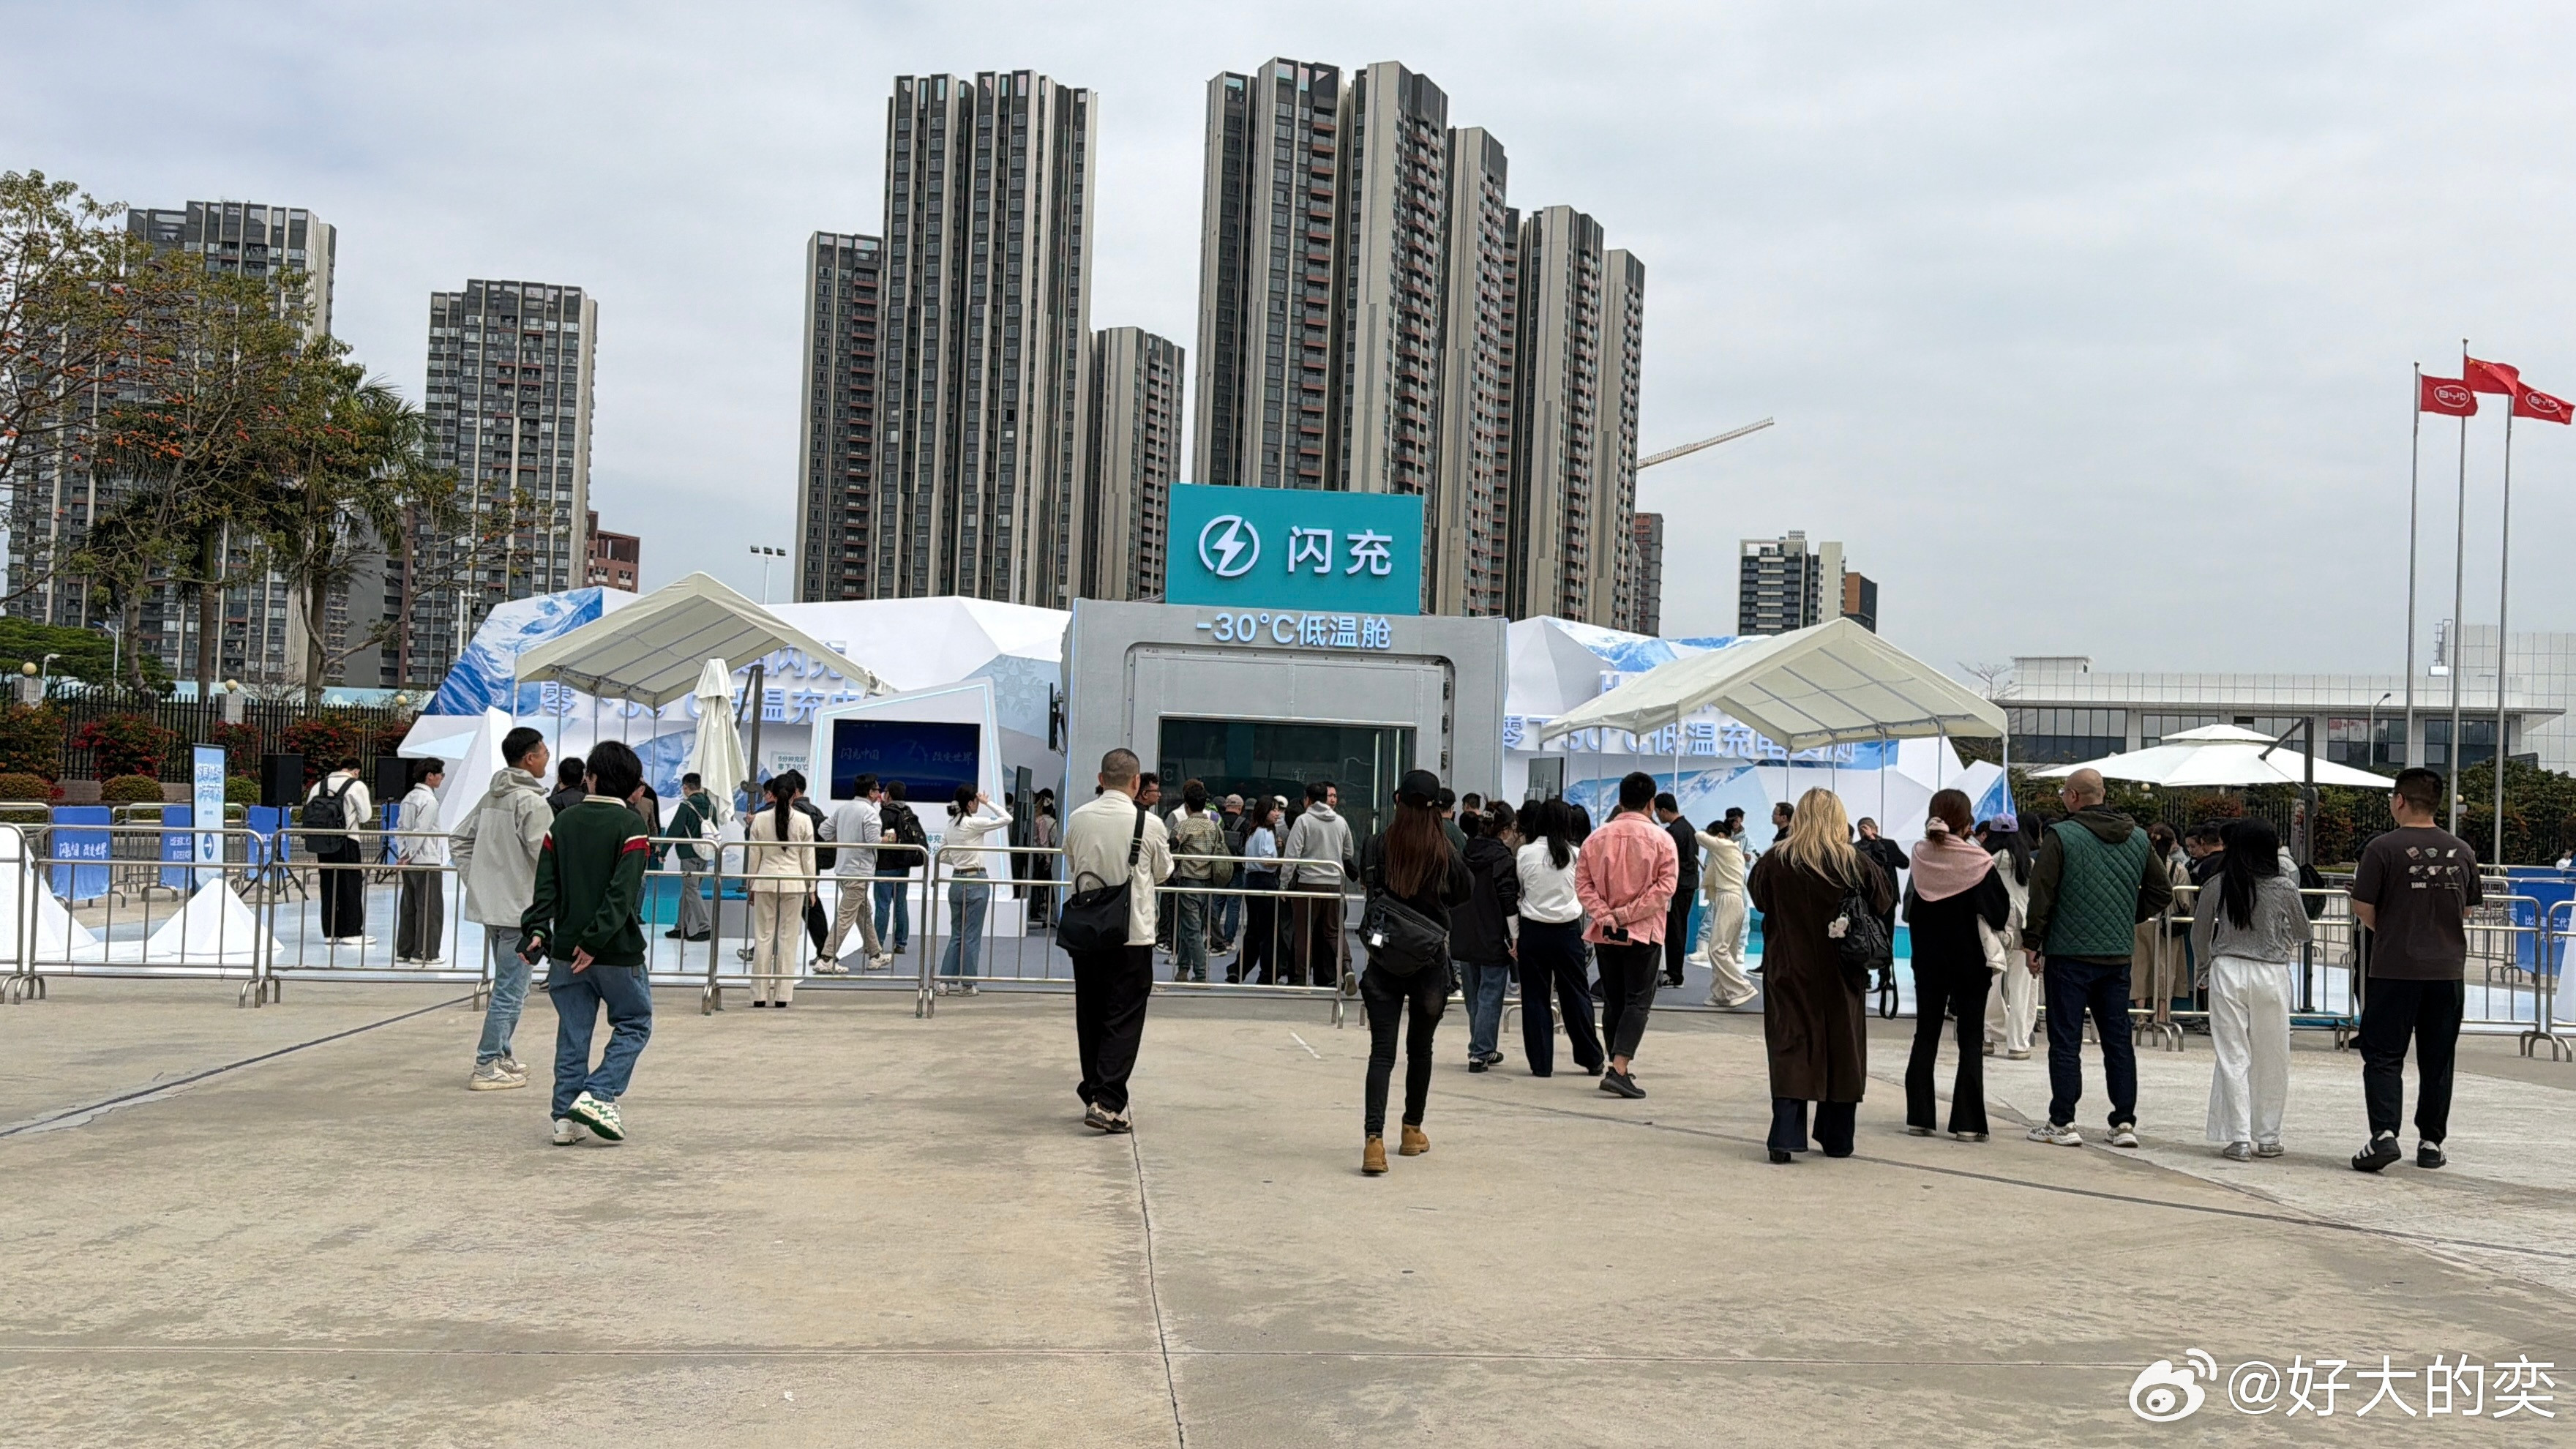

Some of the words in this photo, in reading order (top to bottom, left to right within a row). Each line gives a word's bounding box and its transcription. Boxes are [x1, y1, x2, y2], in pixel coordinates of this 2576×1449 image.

[2438, 389, 2467, 401] BYD
[2530, 395, 2558, 408] BYD
[1288, 525, 1393, 575] 闪充
[1197, 613, 1391, 649] -30°C低温舱
